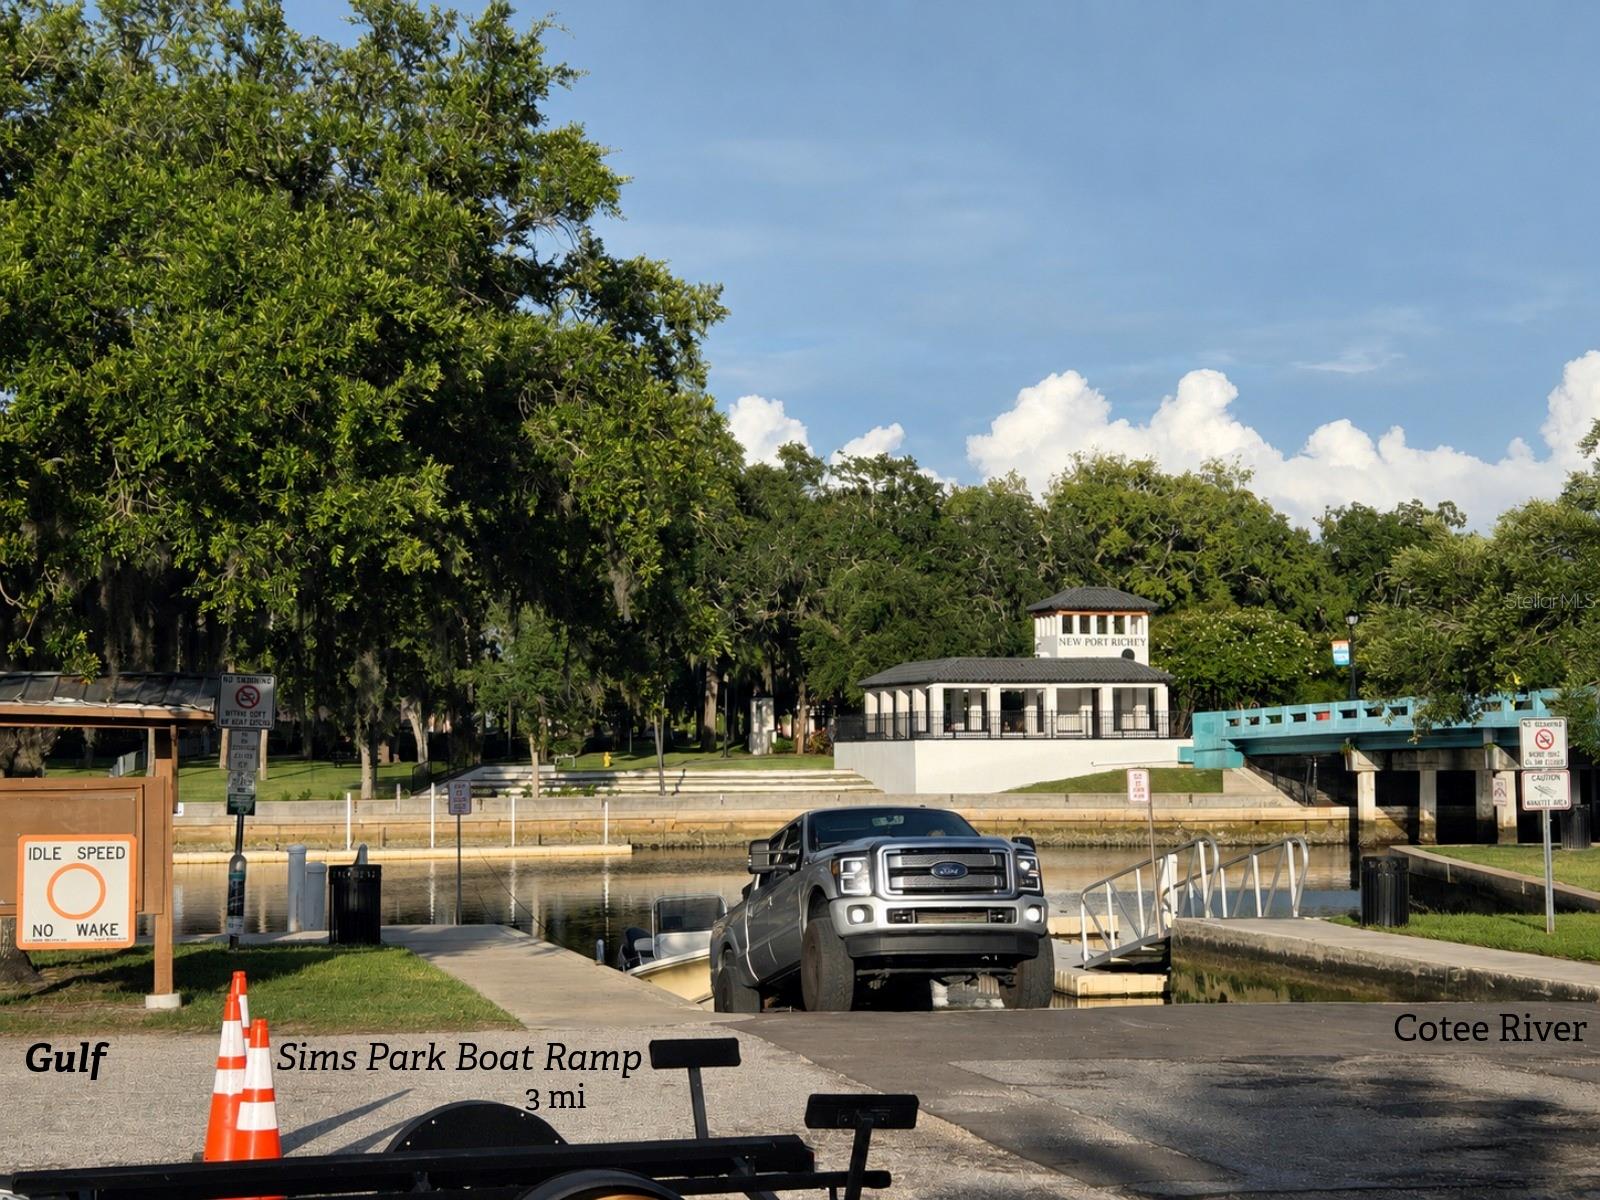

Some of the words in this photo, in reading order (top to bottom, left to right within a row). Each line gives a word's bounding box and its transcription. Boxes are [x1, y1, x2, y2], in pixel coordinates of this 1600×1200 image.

[1059, 638, 1081, 646] NEW
[1085, 638, 1108, 646] PORT
[1111, 638, 1146, 646] RICHEY
[28, 846, 62, 861] IDLE
[77, 846, 126, 860] SPEED
[32, 923, 54, 938] NO
[76, 923, 119, 937] WAKE
